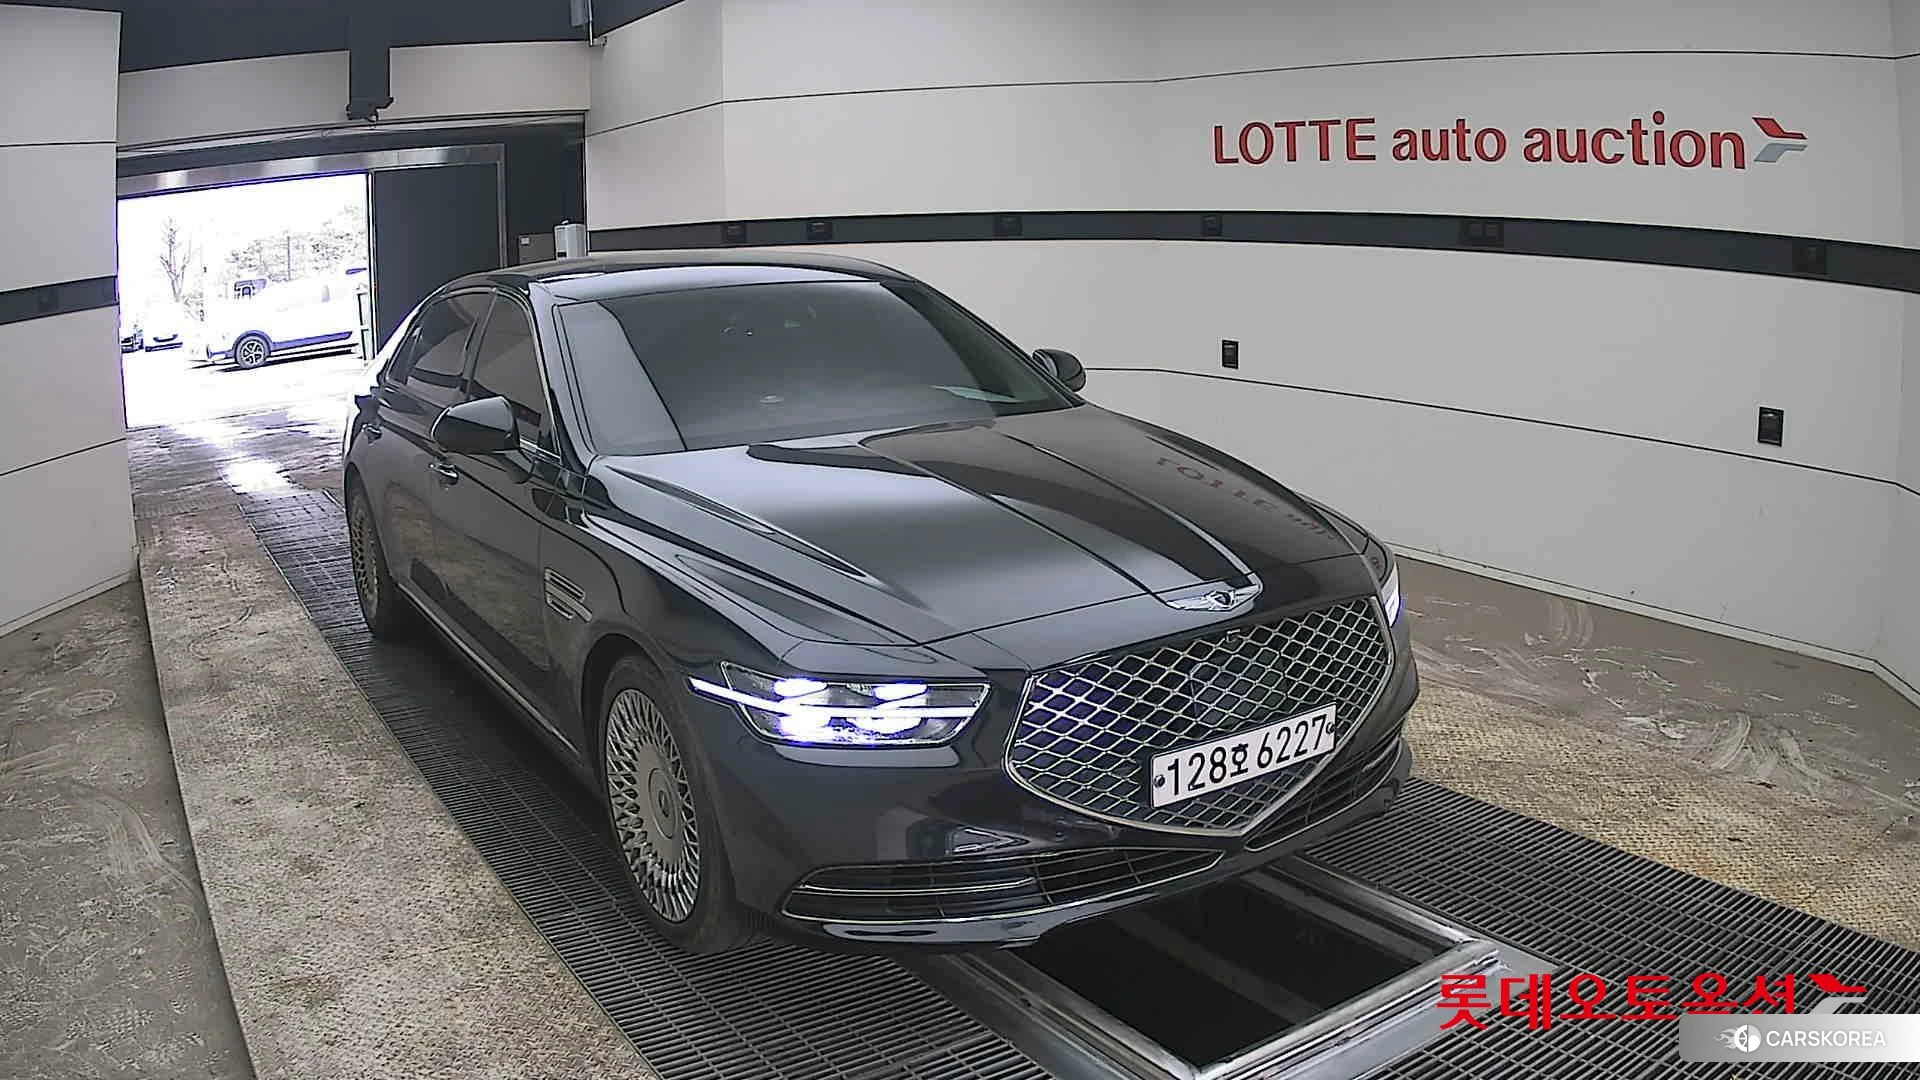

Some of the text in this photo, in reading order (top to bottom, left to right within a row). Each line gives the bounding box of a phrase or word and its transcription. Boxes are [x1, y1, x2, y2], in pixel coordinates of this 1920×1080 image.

[1213, 111, 1746, 170] LOTTE auto auction
[1167, 714, 1328, 796] 128호 6227
